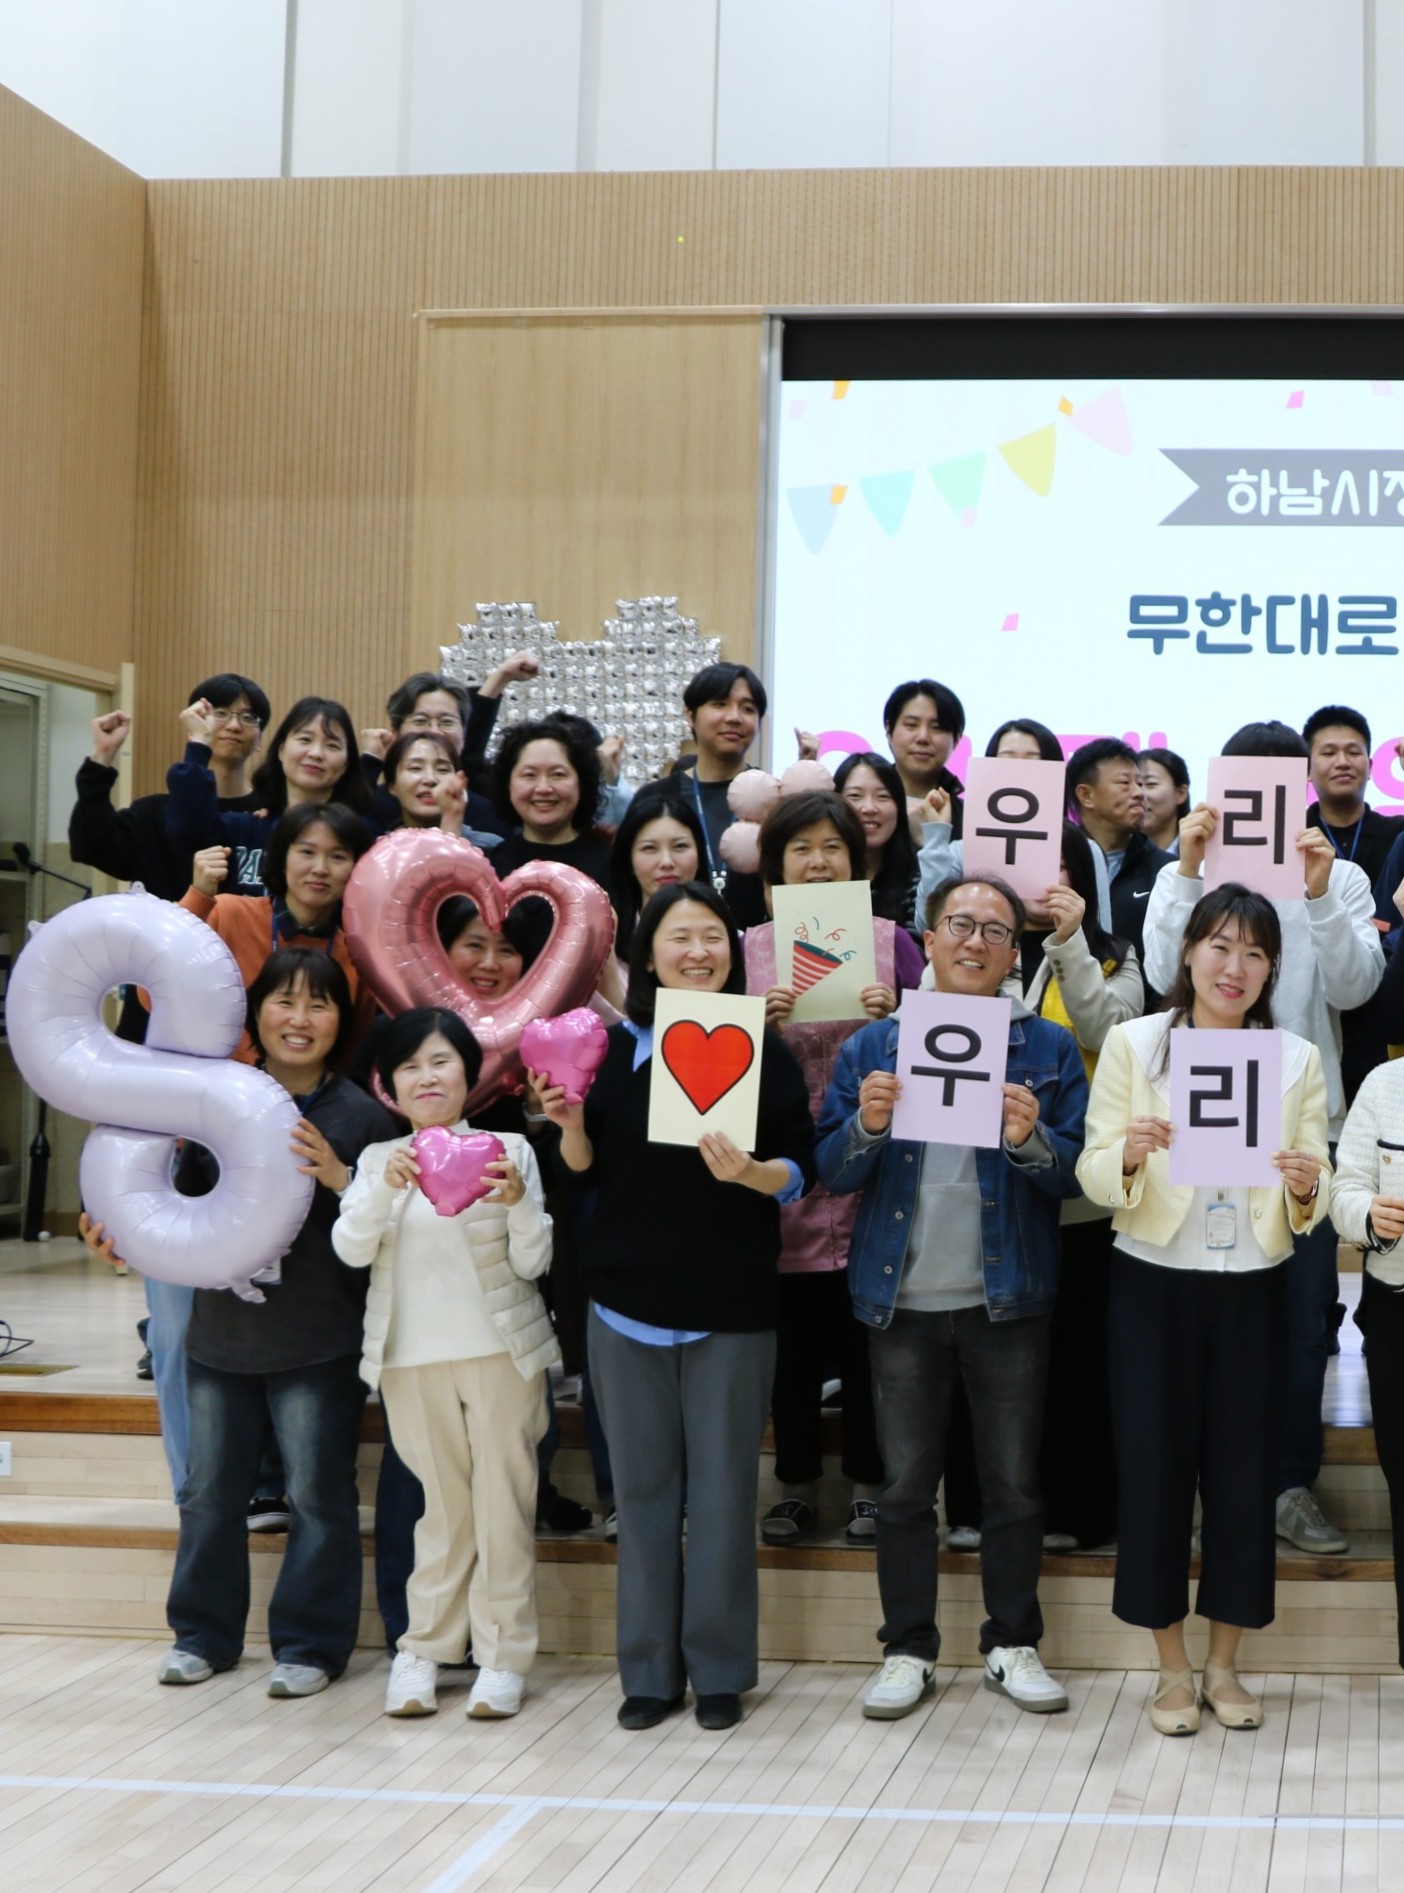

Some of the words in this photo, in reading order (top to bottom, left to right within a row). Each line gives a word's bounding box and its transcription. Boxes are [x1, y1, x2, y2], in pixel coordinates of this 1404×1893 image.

[1127, 592, 1398, 655] 무한대로
[976, 788, 1047, 865] 우
[1223, 785, 1286, 865] 리
[911, 1024, 990, 1106] 우
[1189, 1060, 1259, 1148] 리
